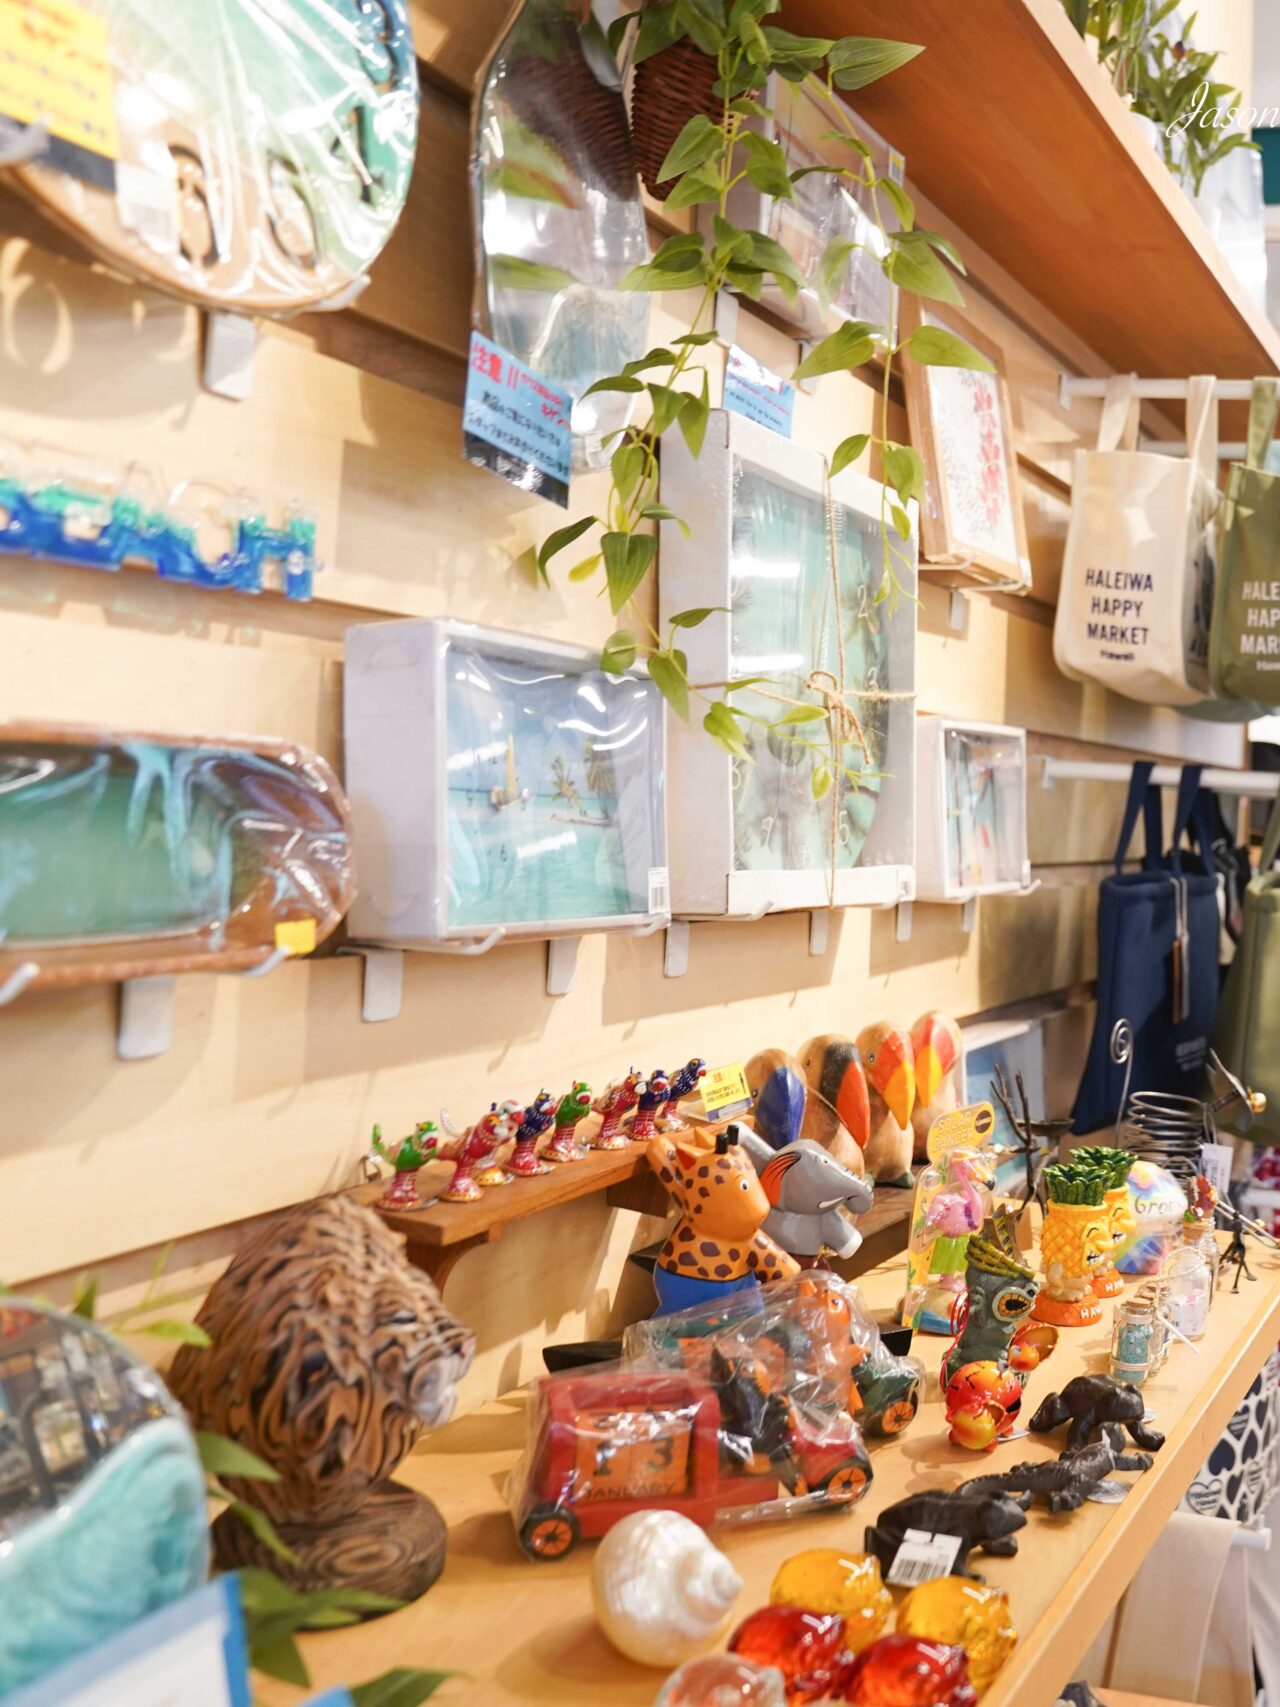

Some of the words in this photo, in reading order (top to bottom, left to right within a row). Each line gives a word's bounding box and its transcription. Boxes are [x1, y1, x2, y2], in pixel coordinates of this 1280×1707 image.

[1085, 568, 1154, 593] HALEIWA
[1090, 596, 1144, 619] HAPPY
[1086, 622, 1150, 646] MARKET
[938, 1111, 972, 1134] SOLAR
[933, 1127, 975, 1153] DANCER
